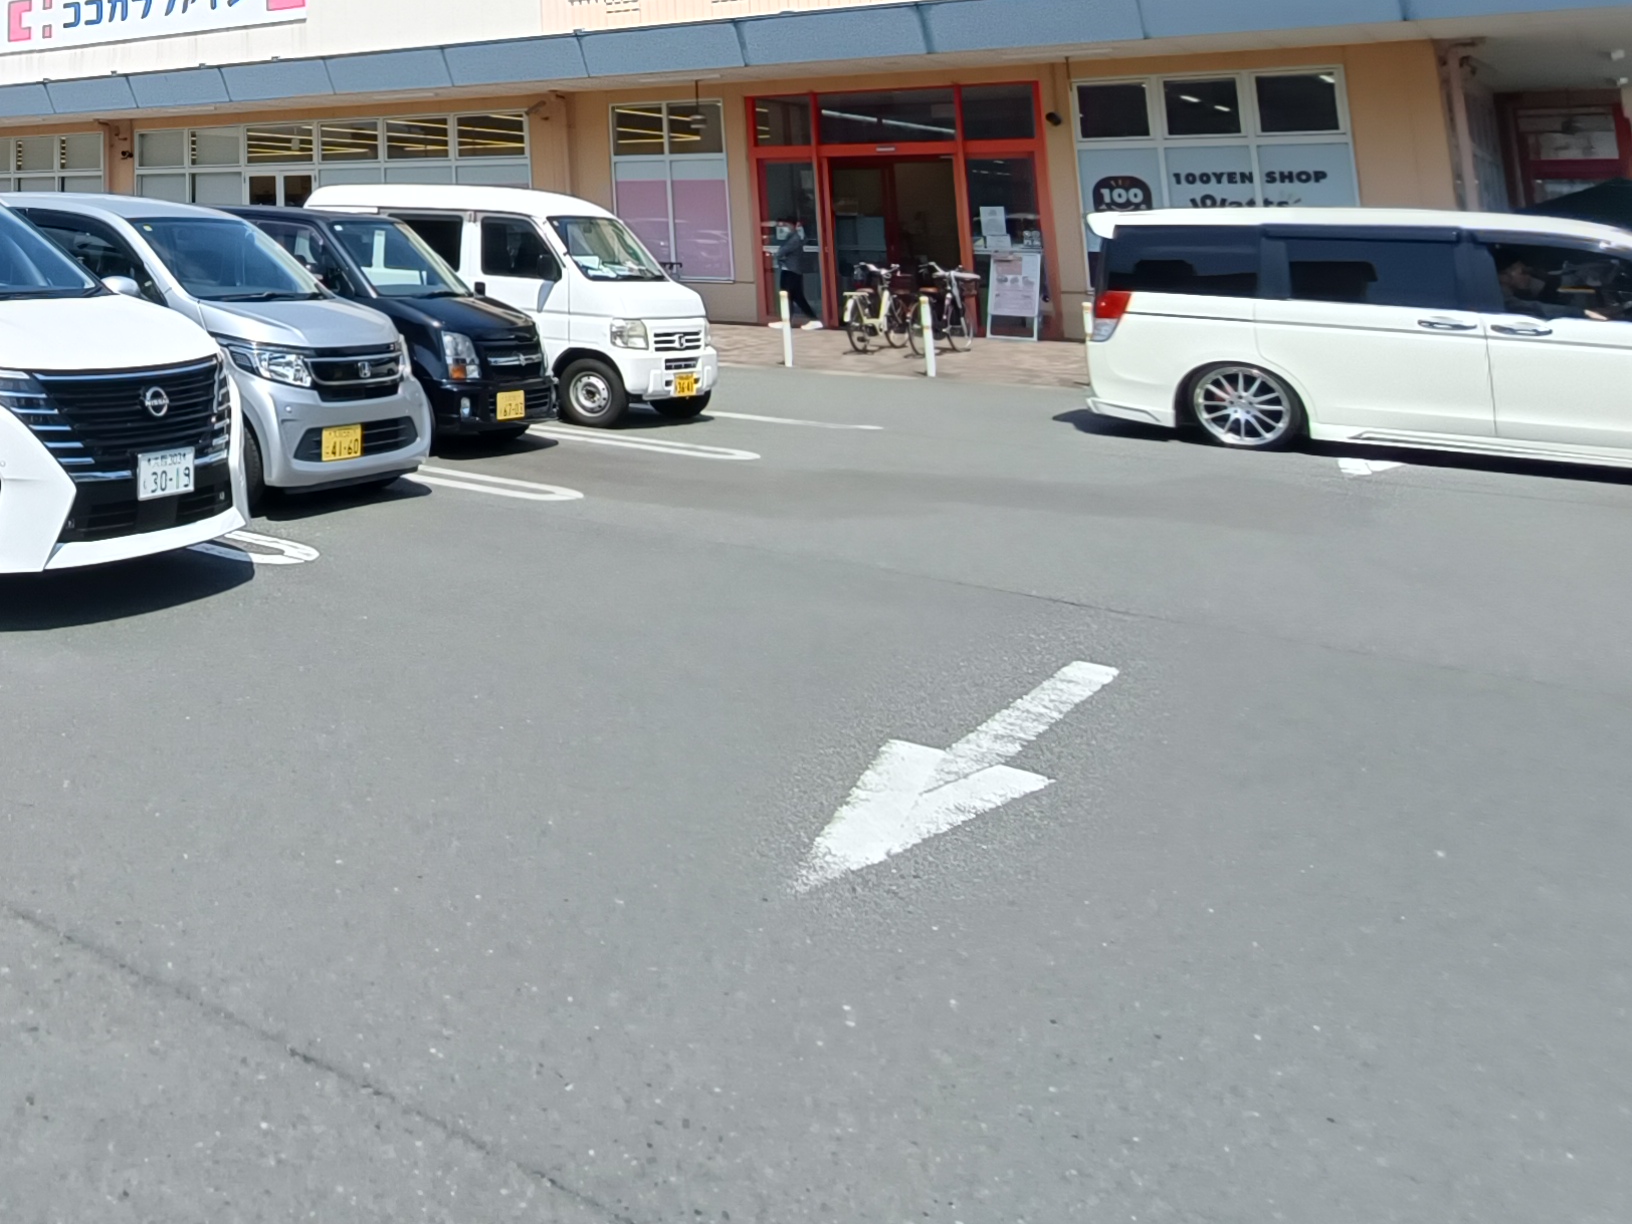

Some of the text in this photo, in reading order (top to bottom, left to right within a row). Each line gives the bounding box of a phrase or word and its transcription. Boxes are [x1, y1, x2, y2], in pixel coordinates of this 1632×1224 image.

[1265, 170, 1328, 184] SHOP
[1100, 187, 1144, 204] 100
[150, 466, 191, 493] 30-19
